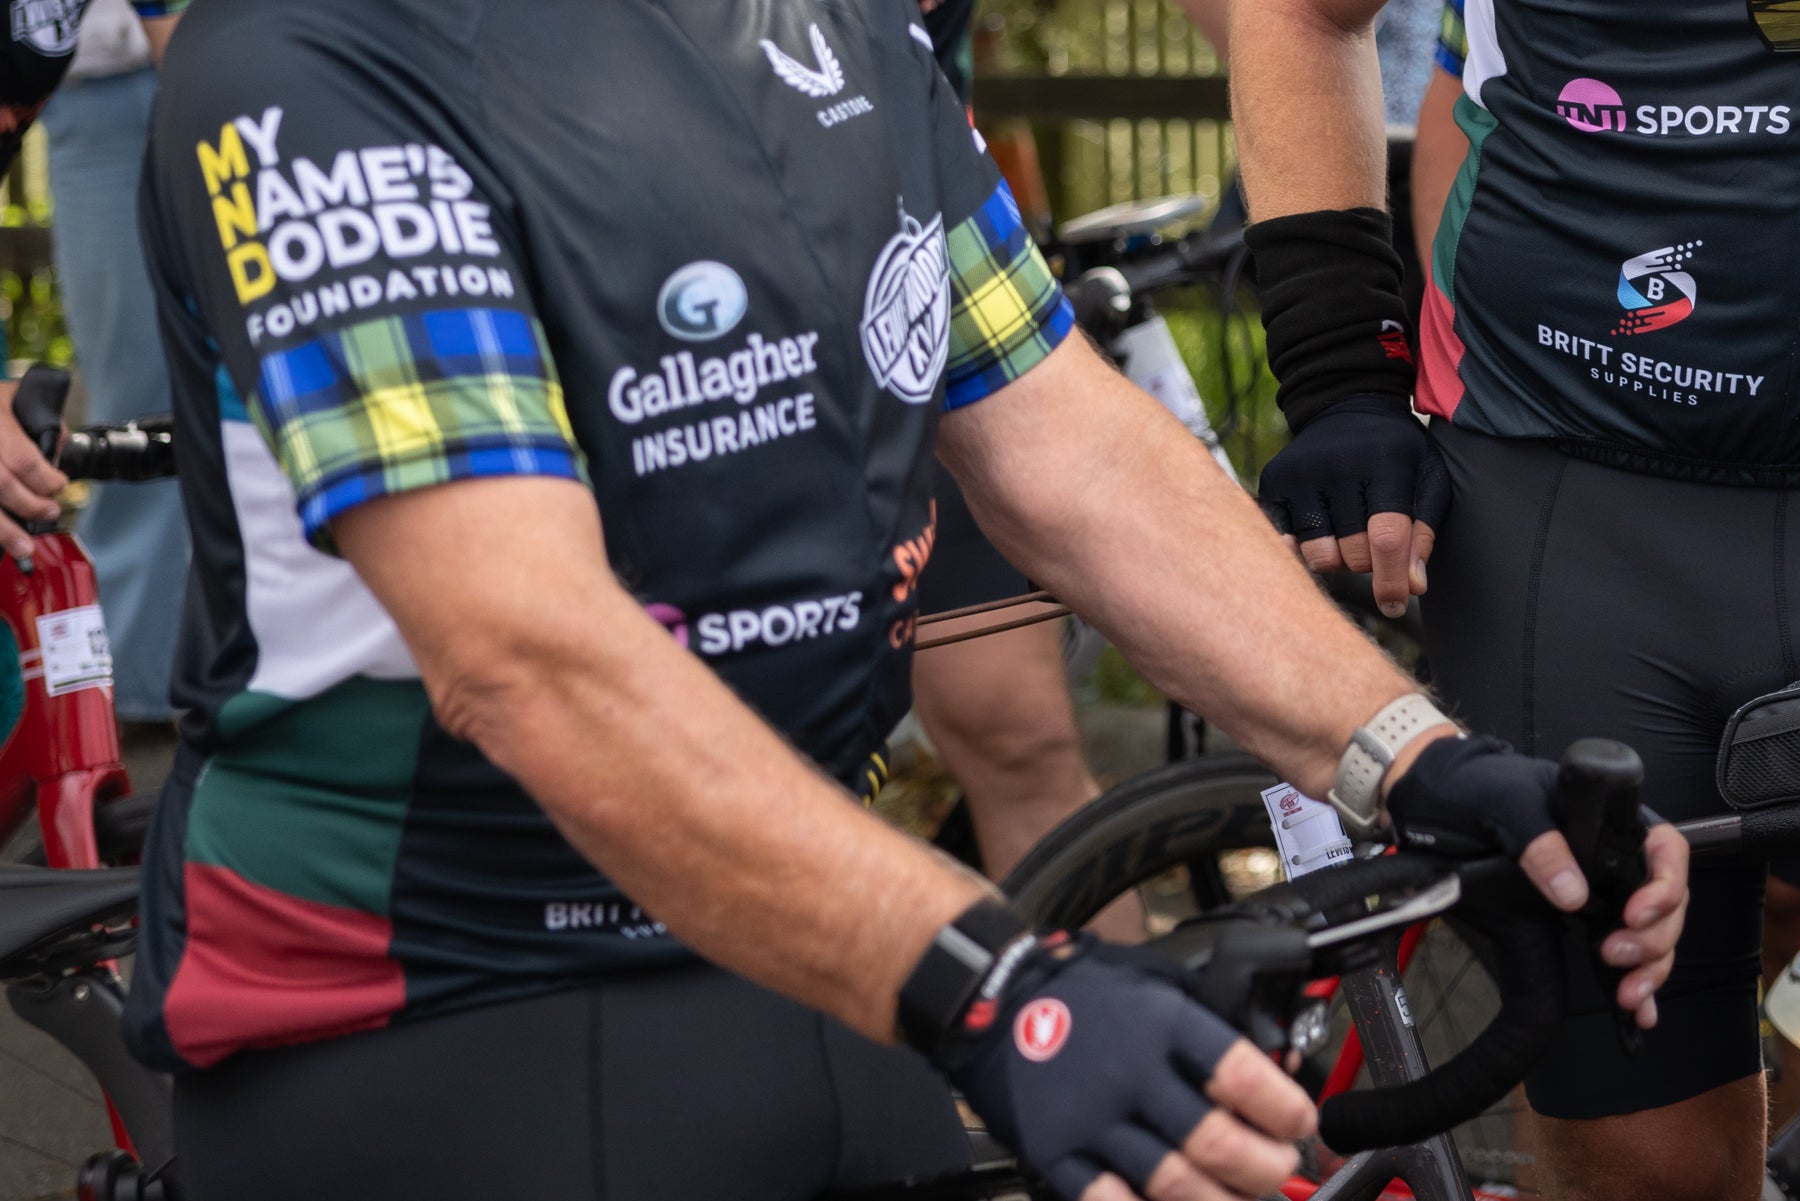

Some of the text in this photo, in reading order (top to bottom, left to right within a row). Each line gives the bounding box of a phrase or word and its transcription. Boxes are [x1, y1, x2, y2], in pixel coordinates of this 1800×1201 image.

[197, 106, 283, 196] MY
[1636, 105, 1791, 135] SPORTS
[211, 143, 474, 250] NAME'S
[226, 199, 501, 305] DODDIE
[245, 263, 515, 346] FOUNDATION
[607, 332, 819, 424] Gallagher
[1537, 324, 1765, 397] BRITT SECURITY
[1590, 367, 1698, 406] SUPPLIES
[631, 393, 817, 477] INSURANCE
[698, 591, 863, 655] SPORTS
